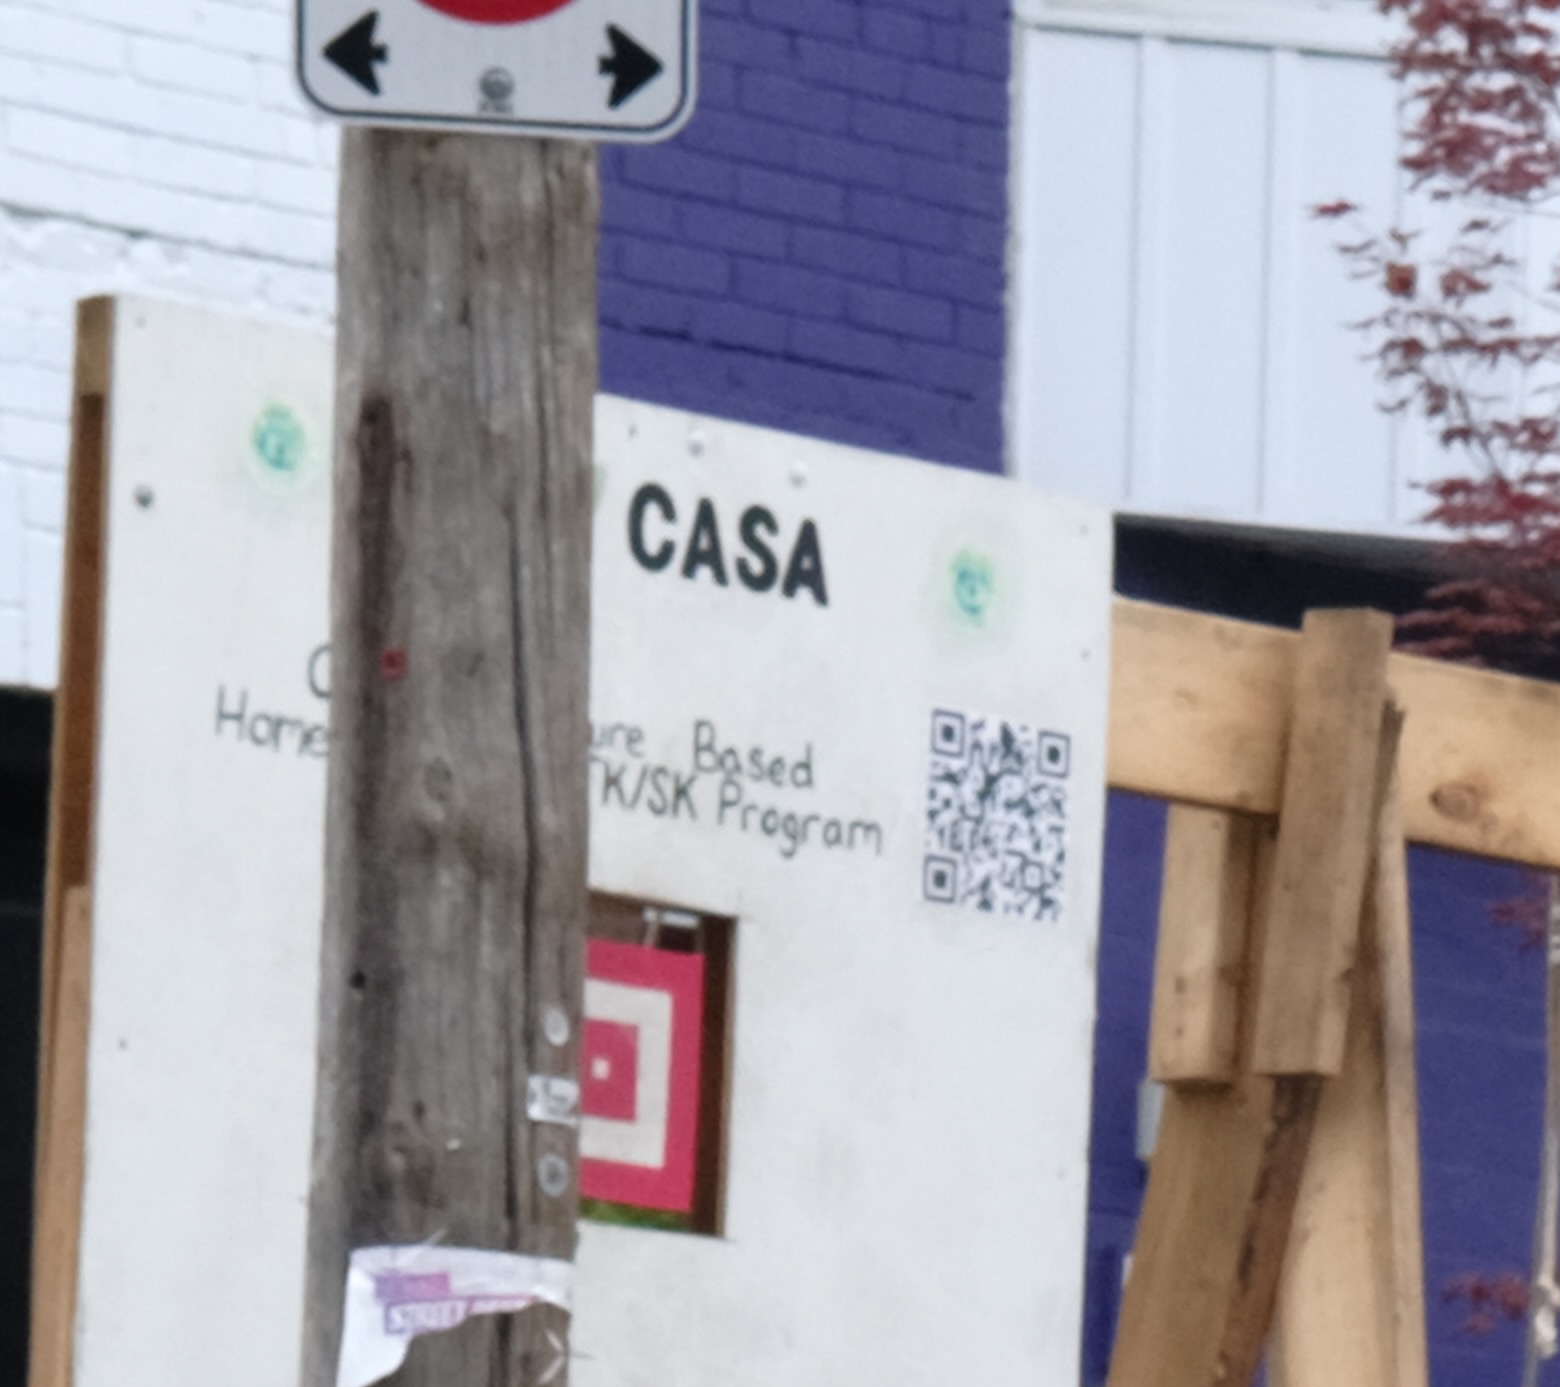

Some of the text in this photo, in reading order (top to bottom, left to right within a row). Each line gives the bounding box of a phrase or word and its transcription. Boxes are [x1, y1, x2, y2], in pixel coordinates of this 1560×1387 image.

[628, 483, 828, 607] CASA
[589, 753, 883, 859] K/SK Program
[694, 719, 814, 790] Based
